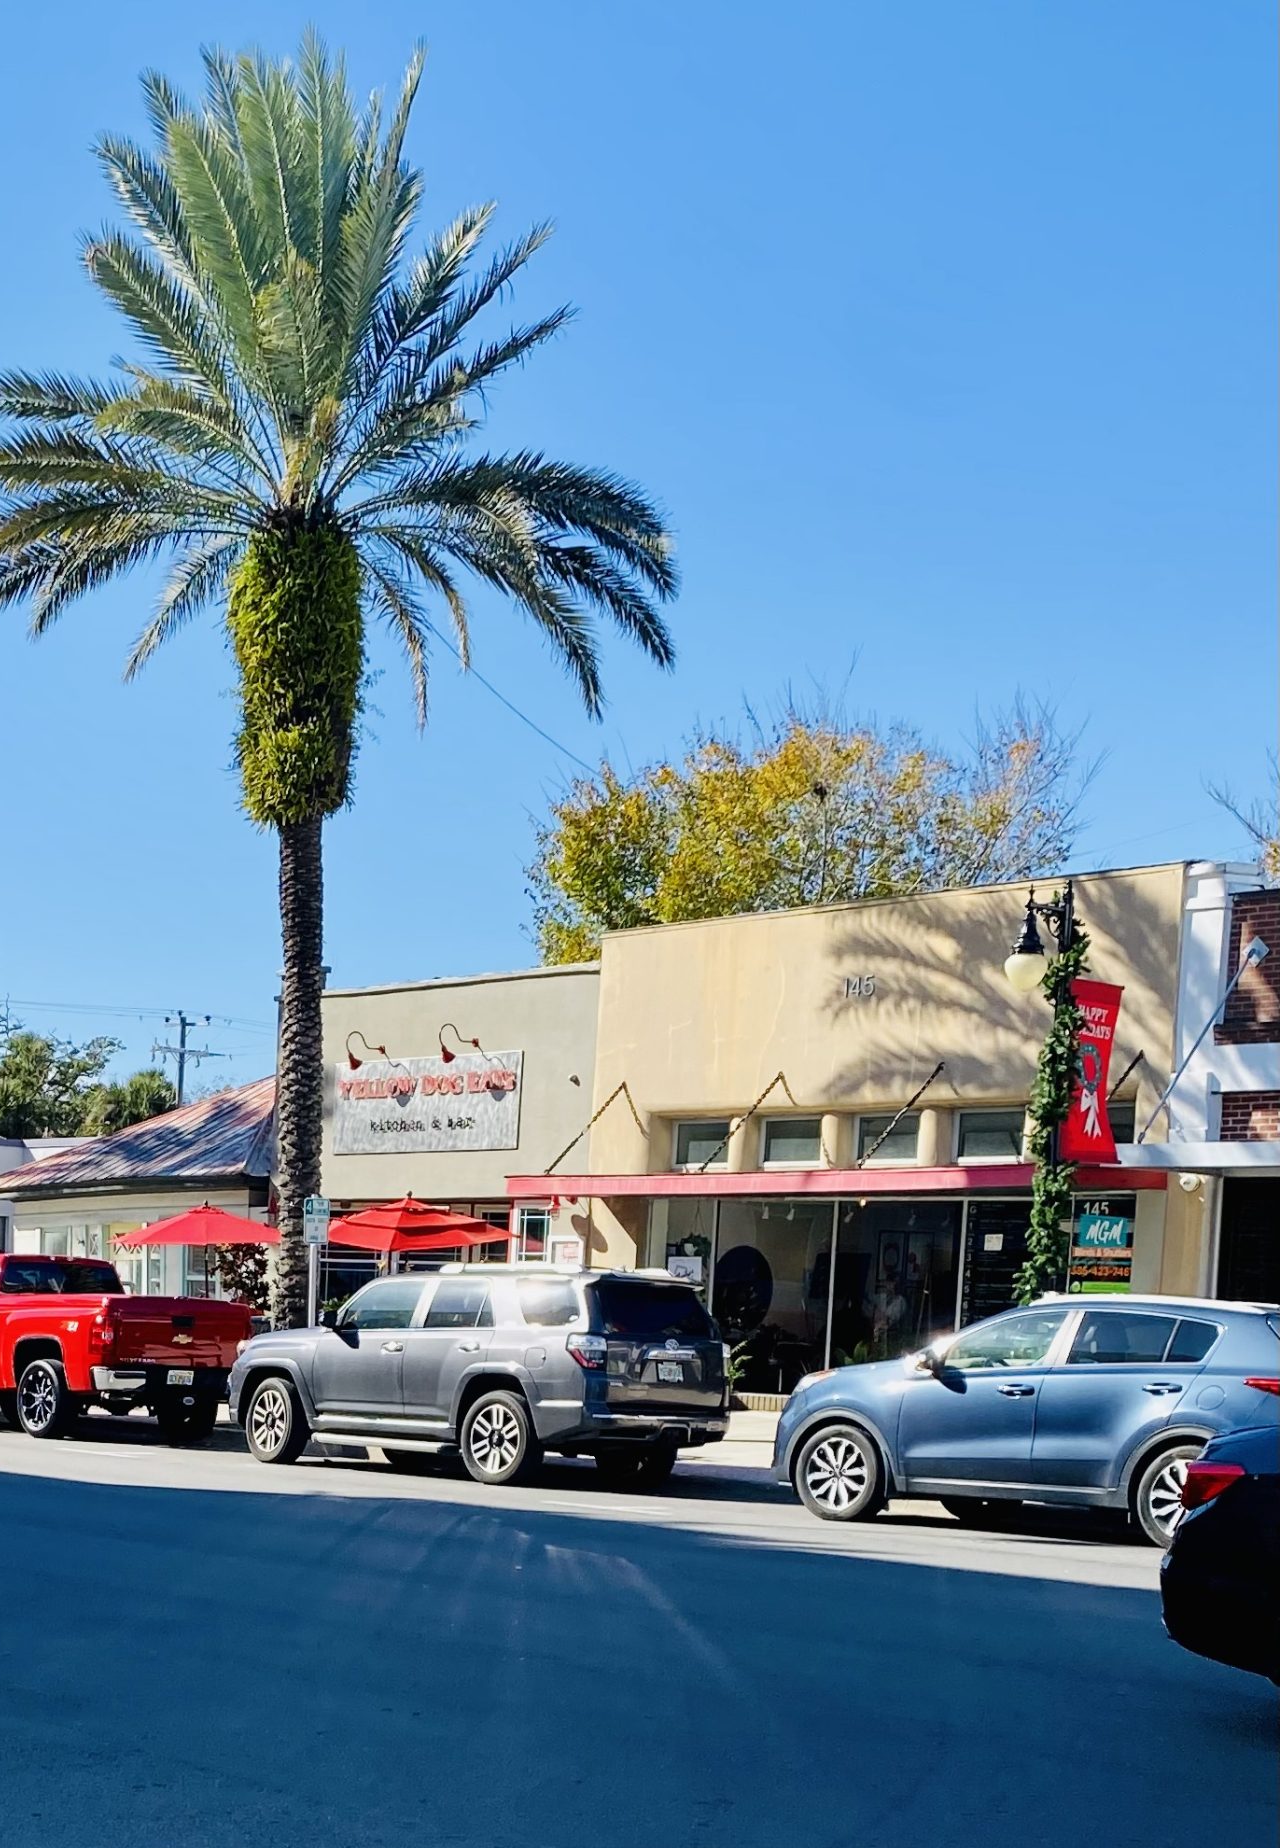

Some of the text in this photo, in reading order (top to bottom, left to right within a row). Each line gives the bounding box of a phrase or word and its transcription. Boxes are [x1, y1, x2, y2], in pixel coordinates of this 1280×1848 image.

[844, 974, 875, 998] 145
[340, 1076, 417, 1100] YELLOW
[420, 1074, 464, 1096] DOG
[431, 1117, 442, 1130] &
[1084, 1202, 1109, 1215] 145
[1086, 1219, 1124, 1245] MGM
